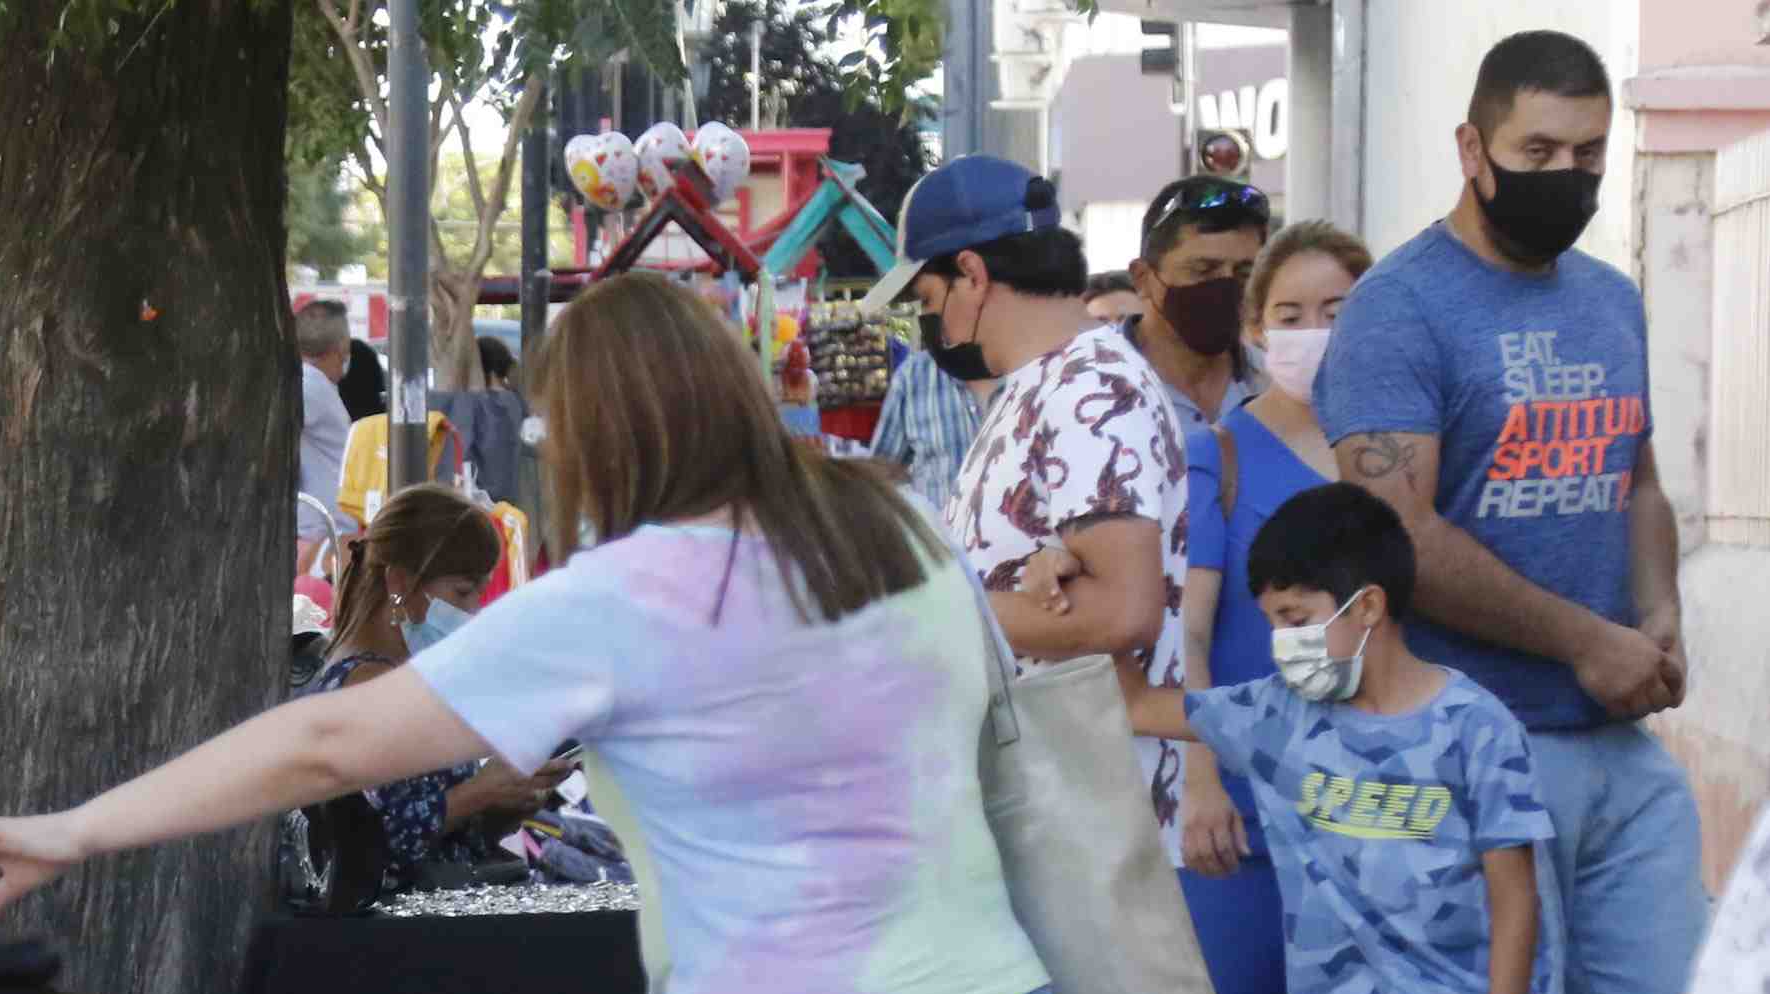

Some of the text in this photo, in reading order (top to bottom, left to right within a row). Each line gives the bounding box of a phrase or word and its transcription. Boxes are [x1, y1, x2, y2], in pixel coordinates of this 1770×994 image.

[1498, 331, 1561, 368] EAT.
[1502, 363, 1608, 404] SLEEP.
[1487, 434, 1614, 481] SPORT
[1296, 771, 1452, 832] SPEED
